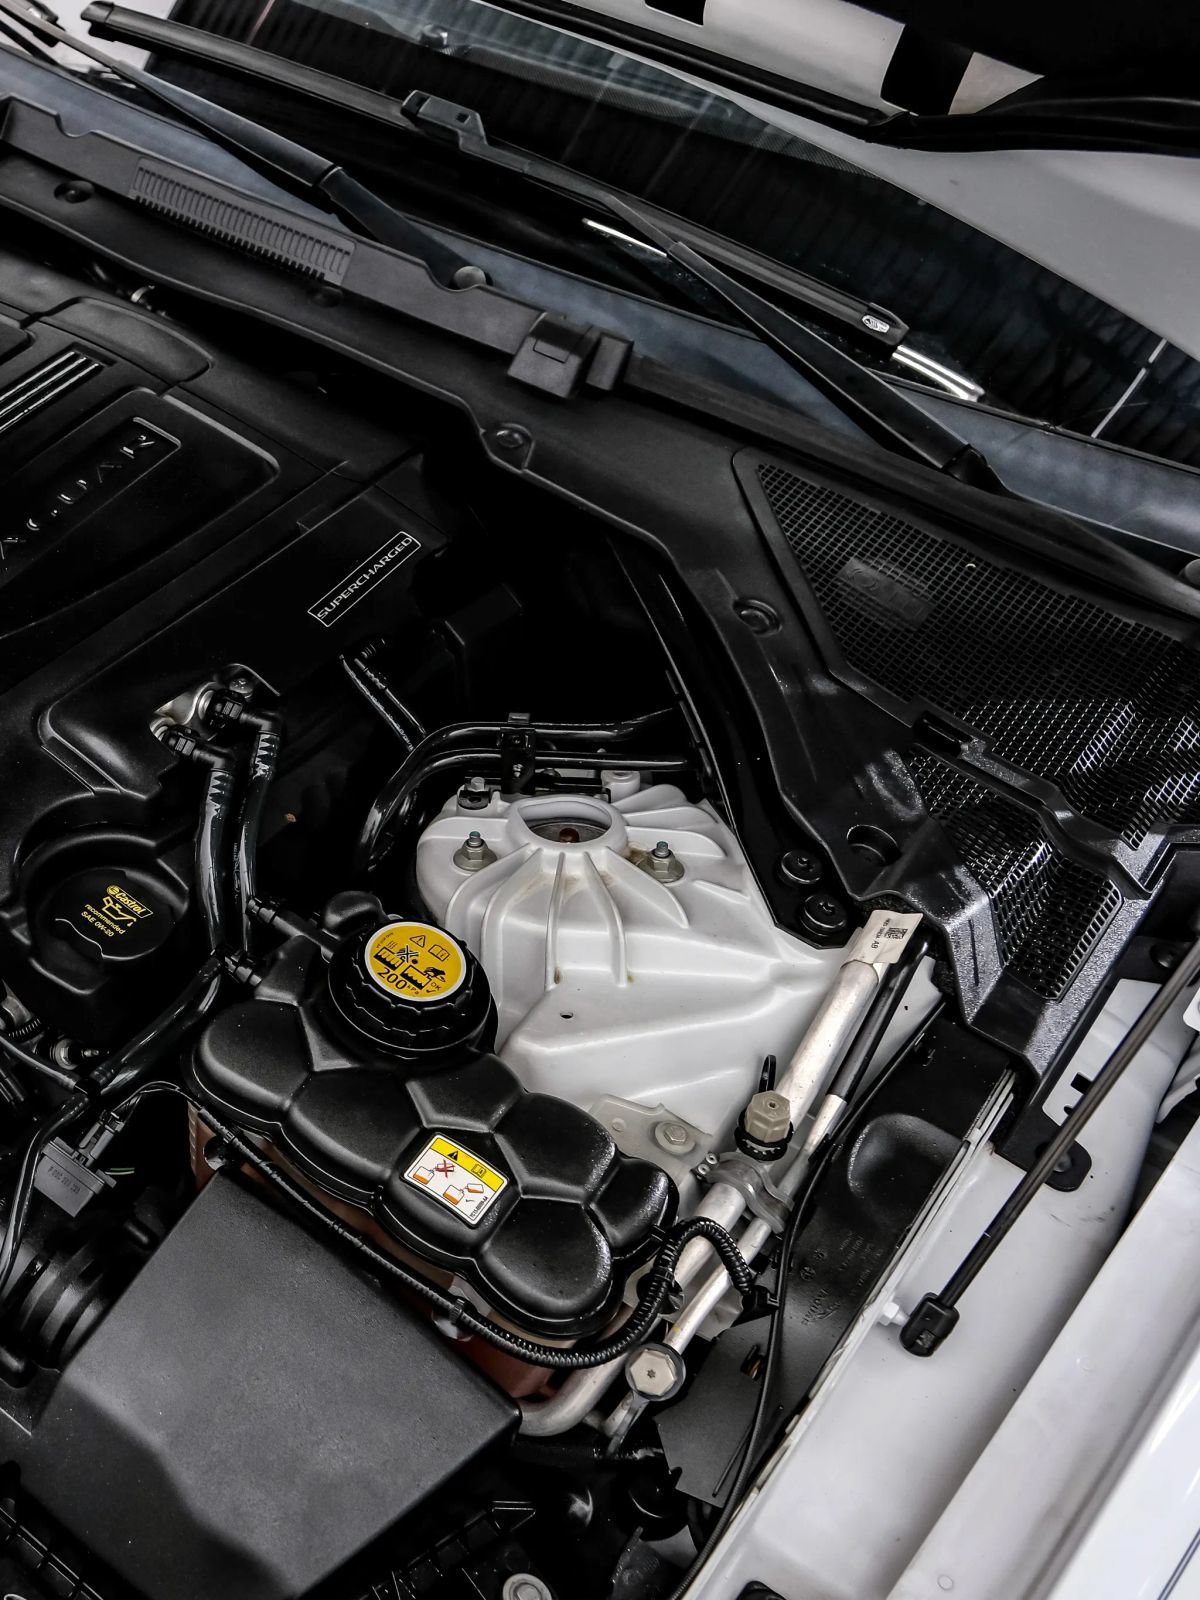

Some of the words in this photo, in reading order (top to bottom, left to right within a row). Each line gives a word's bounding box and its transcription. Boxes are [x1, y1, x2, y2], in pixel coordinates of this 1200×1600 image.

[316, 537, 413, 620] SUPERCHARGED
[115, 892, 147, 915] Castrol
[81, 911, 96, 923] SAE
[84, 903, 127, 935] recommended
[377, 966, 408, 990] 200
[431, 982, 441, 990] OK
